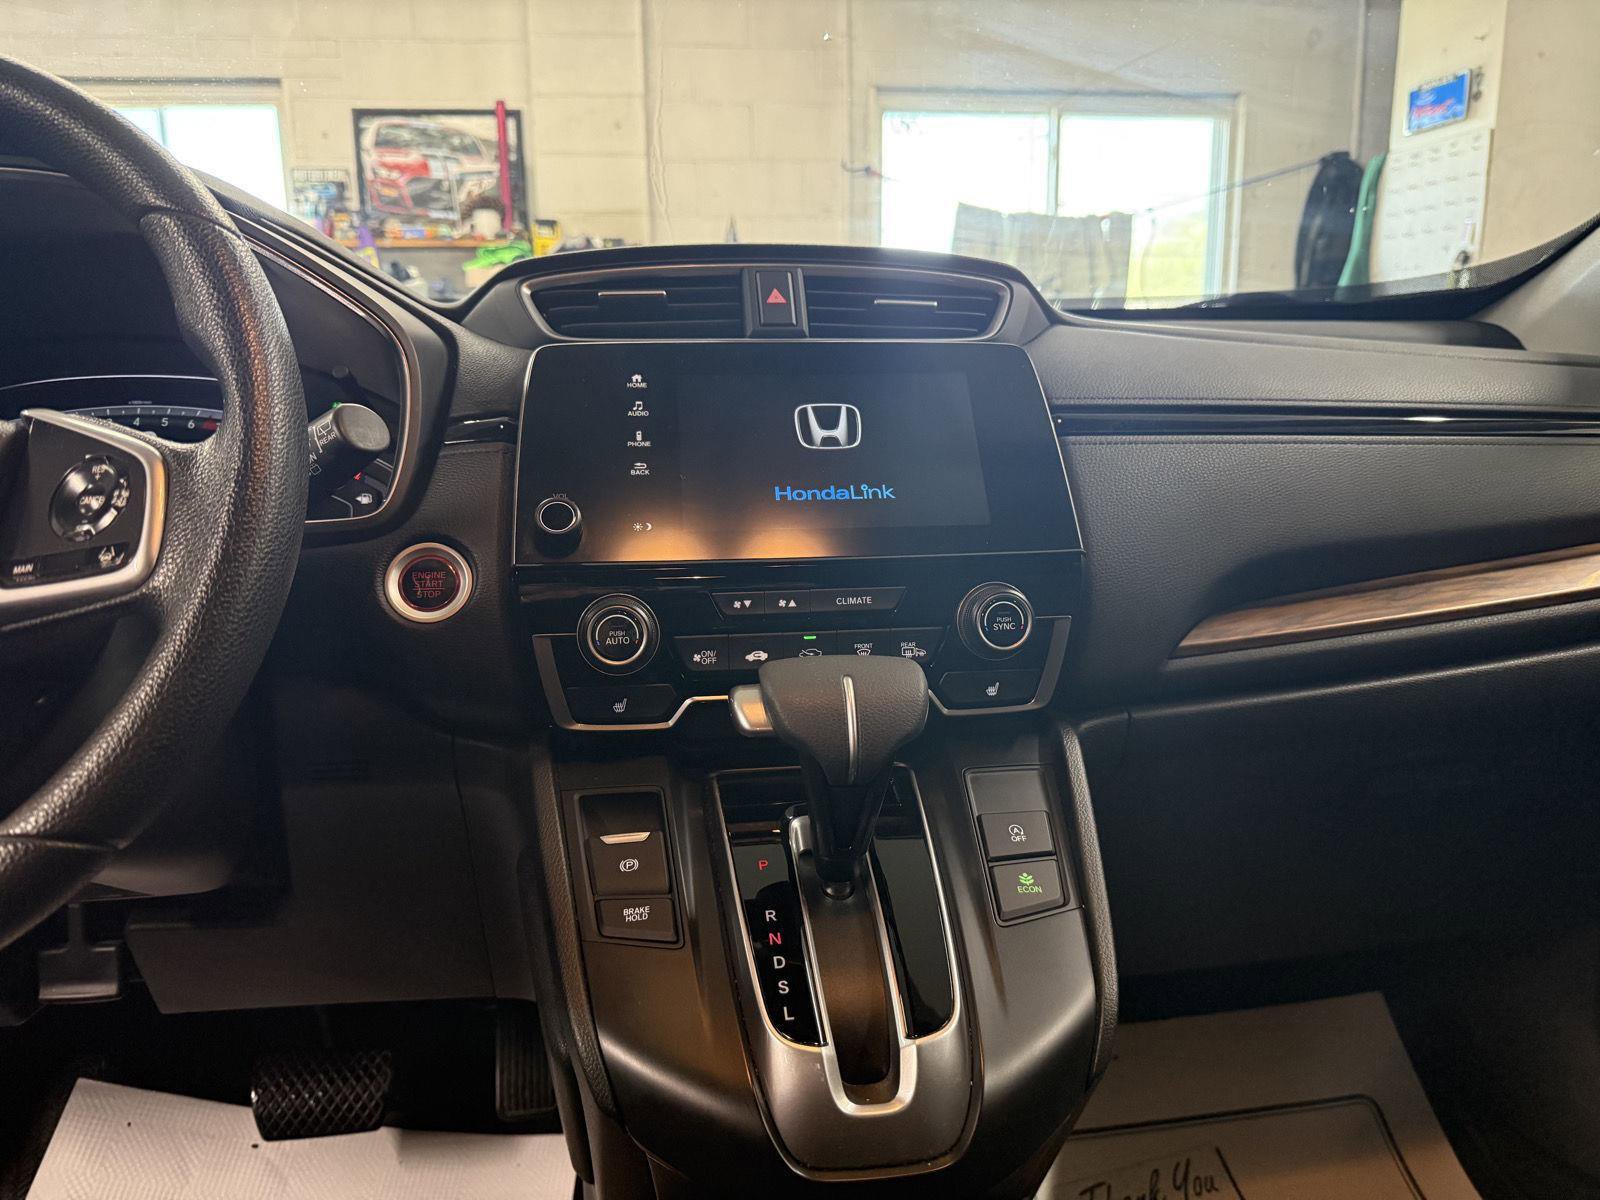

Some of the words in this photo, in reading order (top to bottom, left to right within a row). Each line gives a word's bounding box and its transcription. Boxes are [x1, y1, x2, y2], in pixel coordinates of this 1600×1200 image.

[133, 416, 140, 426] 4
[161, 417, 169, 427] 5
[187, 418, 196, 429] 6
[320, 431, 337, 446] REAR
[627, 440, 651, 448] PHONE
[774, 483, 896, 501] HondaLink
[12, 562, 34, 576] MAIN
[411, 570, 447, 579] ENGINE
[414, 580, 444, 588] START
[416, 590, 441, 598] STOP
[836, 596, 872, 605] CLIMATE
[992, 623, 1016, 631] SYNC
[605, 636, 630, 646] AUTO
[854, 642, 873, 650] FRONT
[700, 650, 717, 658] ON/
[758, 860, 769, 871] P
[1017, 885, 1043, 893] ECON
[623, 905, 651, 916] BRAKE
[765, 909, 777, 922] R
[625, 912, 649, 923] HOLD
[768, 932, 782, 945] N
[773, 955, 786, 970] D
[778, 980, 790, 994] S
[783, 1006, 795, 1021] L
[1172, 1157, 1219, 1200] You
